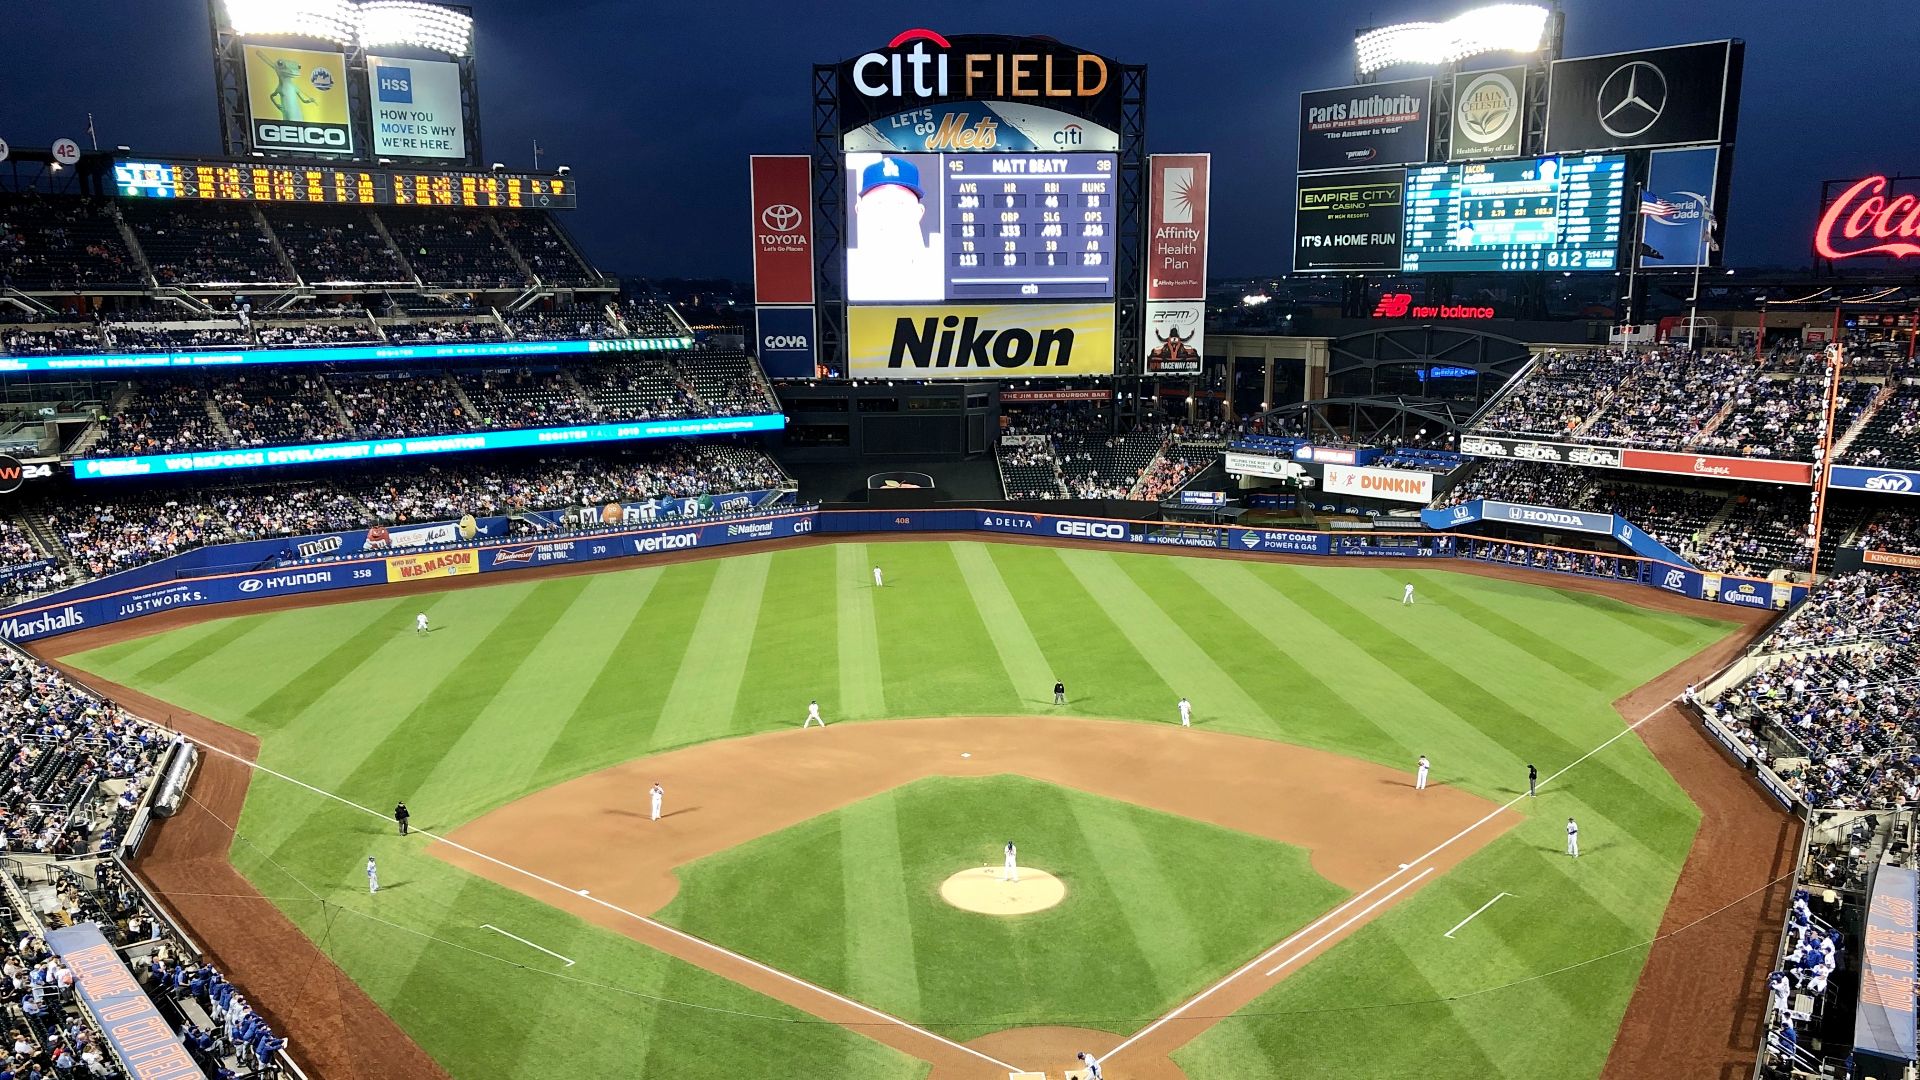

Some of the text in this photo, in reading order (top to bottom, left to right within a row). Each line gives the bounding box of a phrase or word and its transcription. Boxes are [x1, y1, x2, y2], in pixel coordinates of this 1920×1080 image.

[852, 41, 1107, 97] citi FIELD
[381, 78, 409, 92] HSS
[1309, 94, 1421, 123] Parts Authority
[1461, 91, 1515, 113] HAIN CELESTIAL
[380, 110, 434, 122] HOW YOU
[890, 109, 936, 136] LET'S GO
[1386, 114, 1416, 122] Stores
[258, 124, 346, 147] GEICO
[381, 123, 456, 136] MOVE IS WHY
[925, 113, 998, 149] Mets
[1053, 127, 1082, 145] citi
[382, 137, 453, 150] WE'RE HERE.
[55, 144, 76, 159] 42
[231, 162, 289, 170] AMERICAN
[948, 159, 1112, 173] 45 MATT BEATY 3B
[959, 182, 1106, 193] AVG HR RBI RUNS
[1304, 190, 1396, 204] EMPIRE CITY
[1332, 202, 1366, 210] CASINO
[962, 211, 1102, 223] BB OBP SLG OPS
[1672, 210, 1700, 219] Dade
[759, 234, 808, 245] TOYOTA
[1155, 227, 1201, 242] Affinity
[1301, 233, 1396, 248] IT'S A HOME RUN
[962, 241, 1099, 252] TB 2B 3B AB
[1158, 242, 1197, 256] Health
[1164, 257, 1189, 270] Plan
[1153, 310, 1190, 319] RPM
[1413, 306, 1439, 318] new
[1440, 304, 1495, 319] balance
[764, 335, 807, 349] GOYA
[888, 315, 1075, 369] Nikon
[165, 452, 264, 470] WORKFORCE
[267, 444, 370, 464] DEVELOPMENT
[374, 442, 402, 456] AND
[538, 430, 587, 442] REGISTER
[22, 464, 53, 479] 24
[1361, 475, 1426, 494] DUNKIN'
[1865, 477, 1904, 491] SNY
[996, 517, 1033, 529] DELTA
[1523, 511, 1583, 526] HONDA
[738, 521, 773, 534] National
[793, 520, 812, 534] citi
[1056, 520, 1125, 539] GEICO
[634, 531, 697, 553] verizon
[1130, 534, 1143, 543] 380
[1157, 536, 1217, 547] KONICA MINOLTA
[1265, 532, 1317, 542] EAST COAST
[538, 542, 575, 552] THIS BUD'S
[592, 545, 606, 554] 370
[1264, 541, 1293, 549] POWER
[1301, 543, 1317, 551] GAS
[1417, 549, 1433, 557] 370
[499, 551, 533, 561] Budweiser
[538, 551, 569, 561] FOR YOU.
[14, 563, 32, 571] CASINO
[353, 569, 372, 579] 358
[266, 571, 332, 589] HYUNDAI
[1724, 590, 1764, 605] Corona
[0, 606, 83, 639] Marshalls
[63, 944, 138, 1002] WELCOME
[98, 996, 153, 1021] TO
[111, 1016, 174, 1047] CITI
